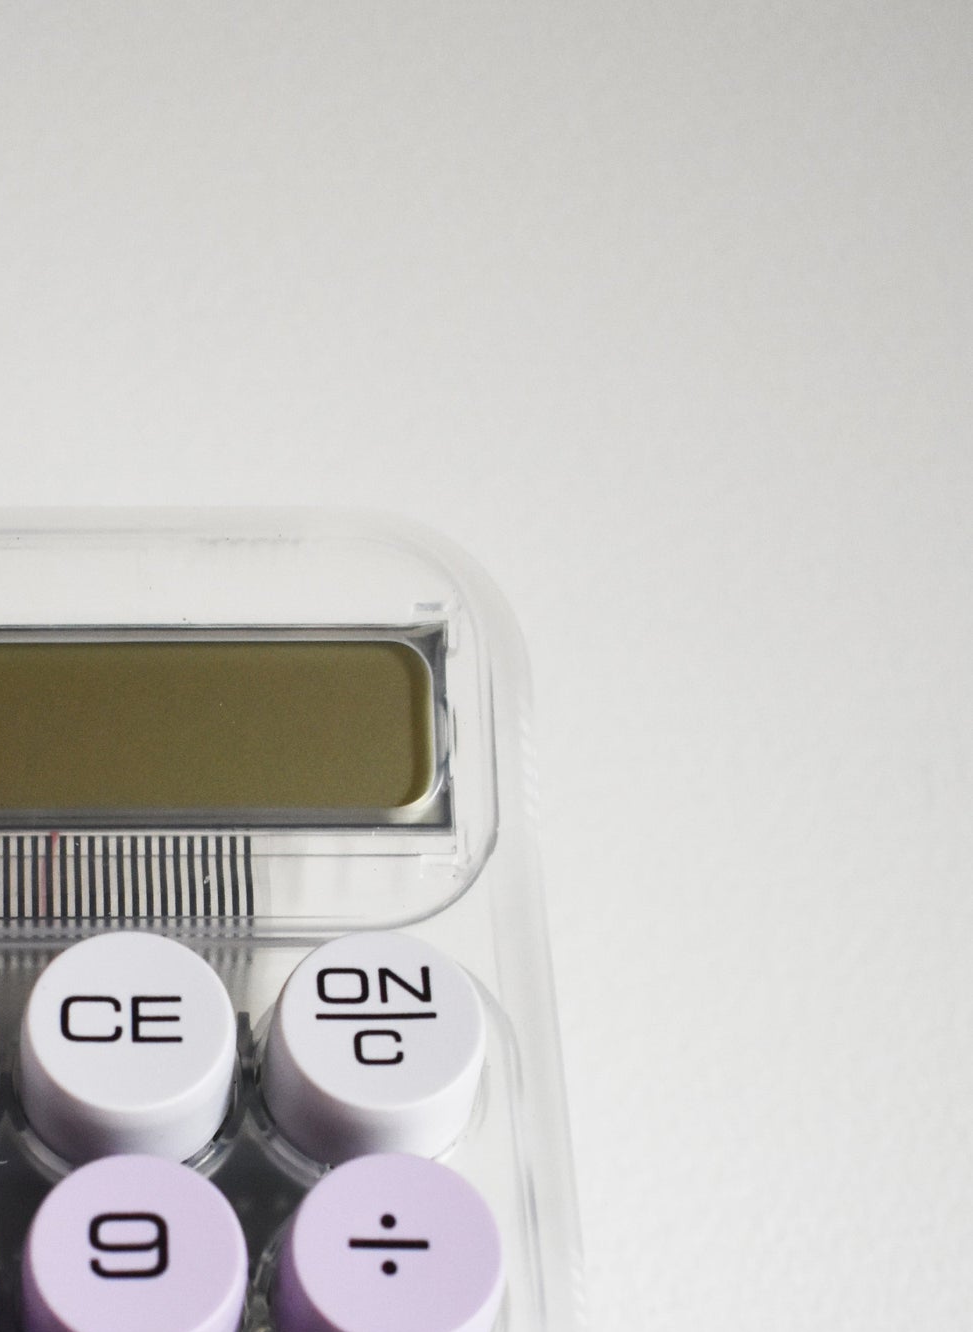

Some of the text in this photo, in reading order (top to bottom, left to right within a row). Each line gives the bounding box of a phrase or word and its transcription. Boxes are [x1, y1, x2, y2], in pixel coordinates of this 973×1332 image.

[316, 965, 432, 1004] ON
[59, 996, 184, 1044] CE
[353, 1029, 405, 1066] C
[88, 1211, 170, 1280] 9
